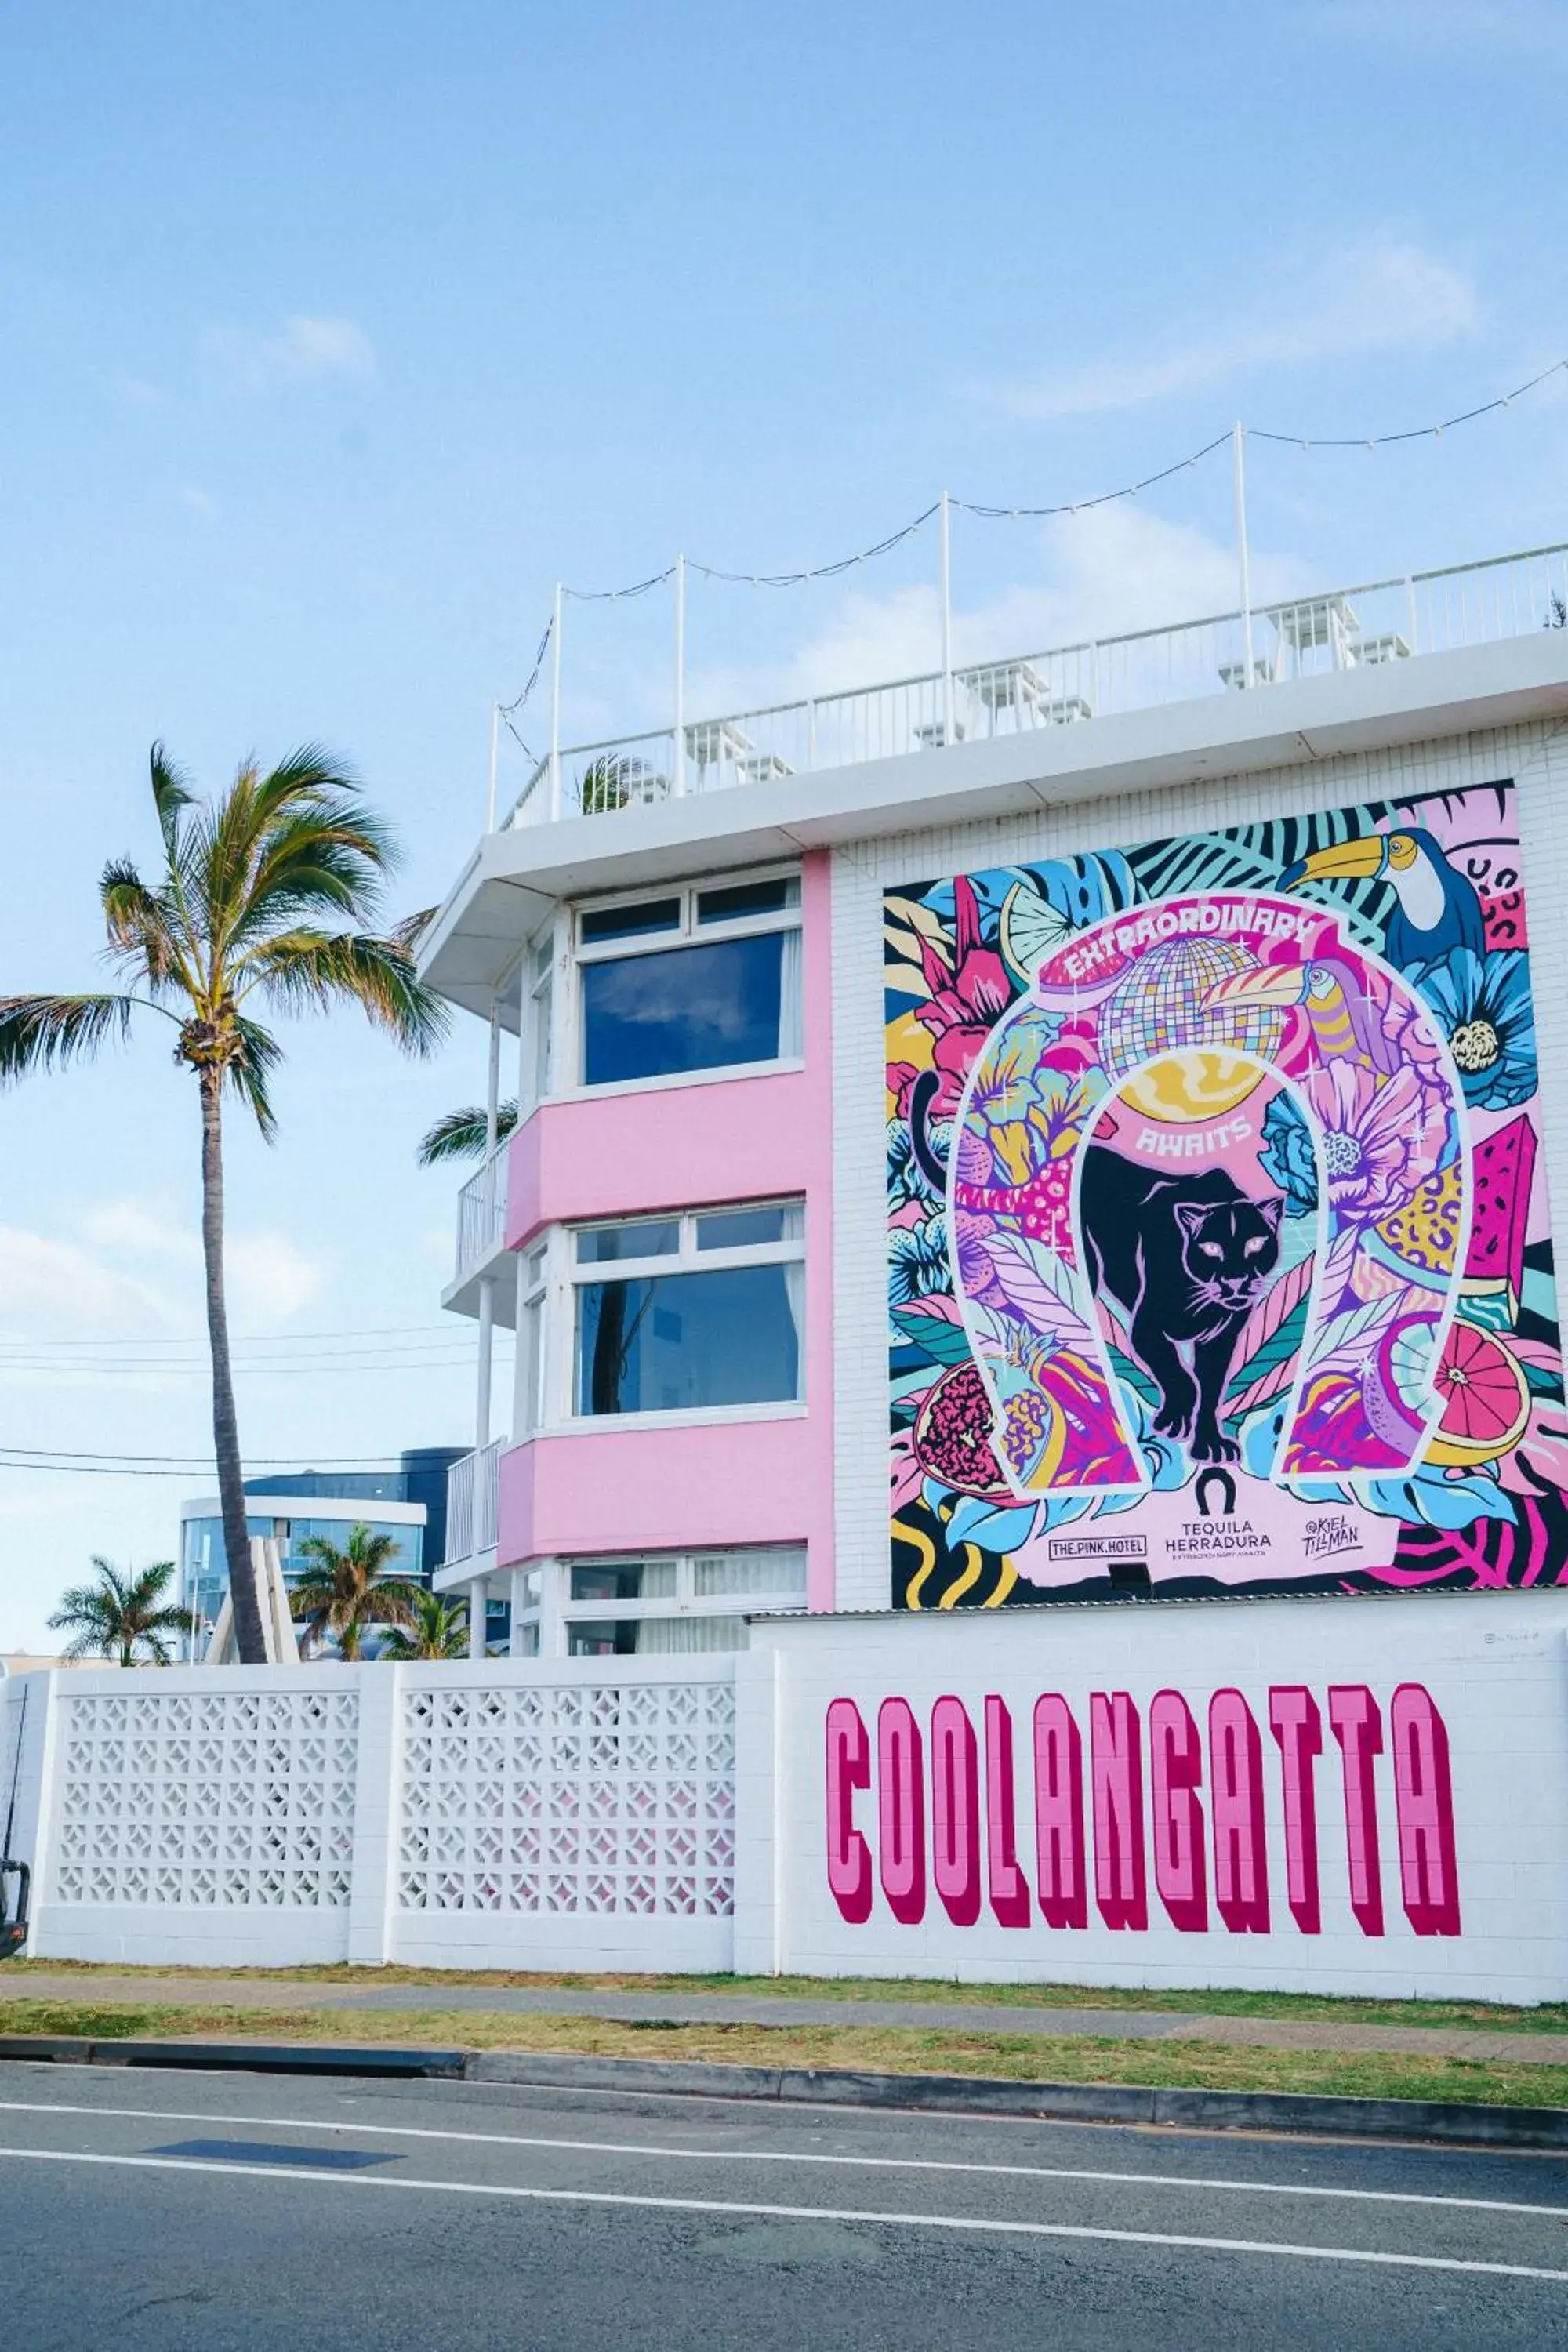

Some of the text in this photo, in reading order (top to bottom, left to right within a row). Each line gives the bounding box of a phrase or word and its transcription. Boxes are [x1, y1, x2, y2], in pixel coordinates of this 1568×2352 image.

[1064, 904, 1316, 979] EXTRAORDINARY
[1135, 1115, 1253, 1157] AWAITS
[1166, 1534, 1272, 1552] HERRADURA
[1182, 1520, 1253, 1536] TEQUILA
[1301, 1526, 1358, 1556] TILLMAN
[826, 1682, 1462, 1937] COOLANGATTA
